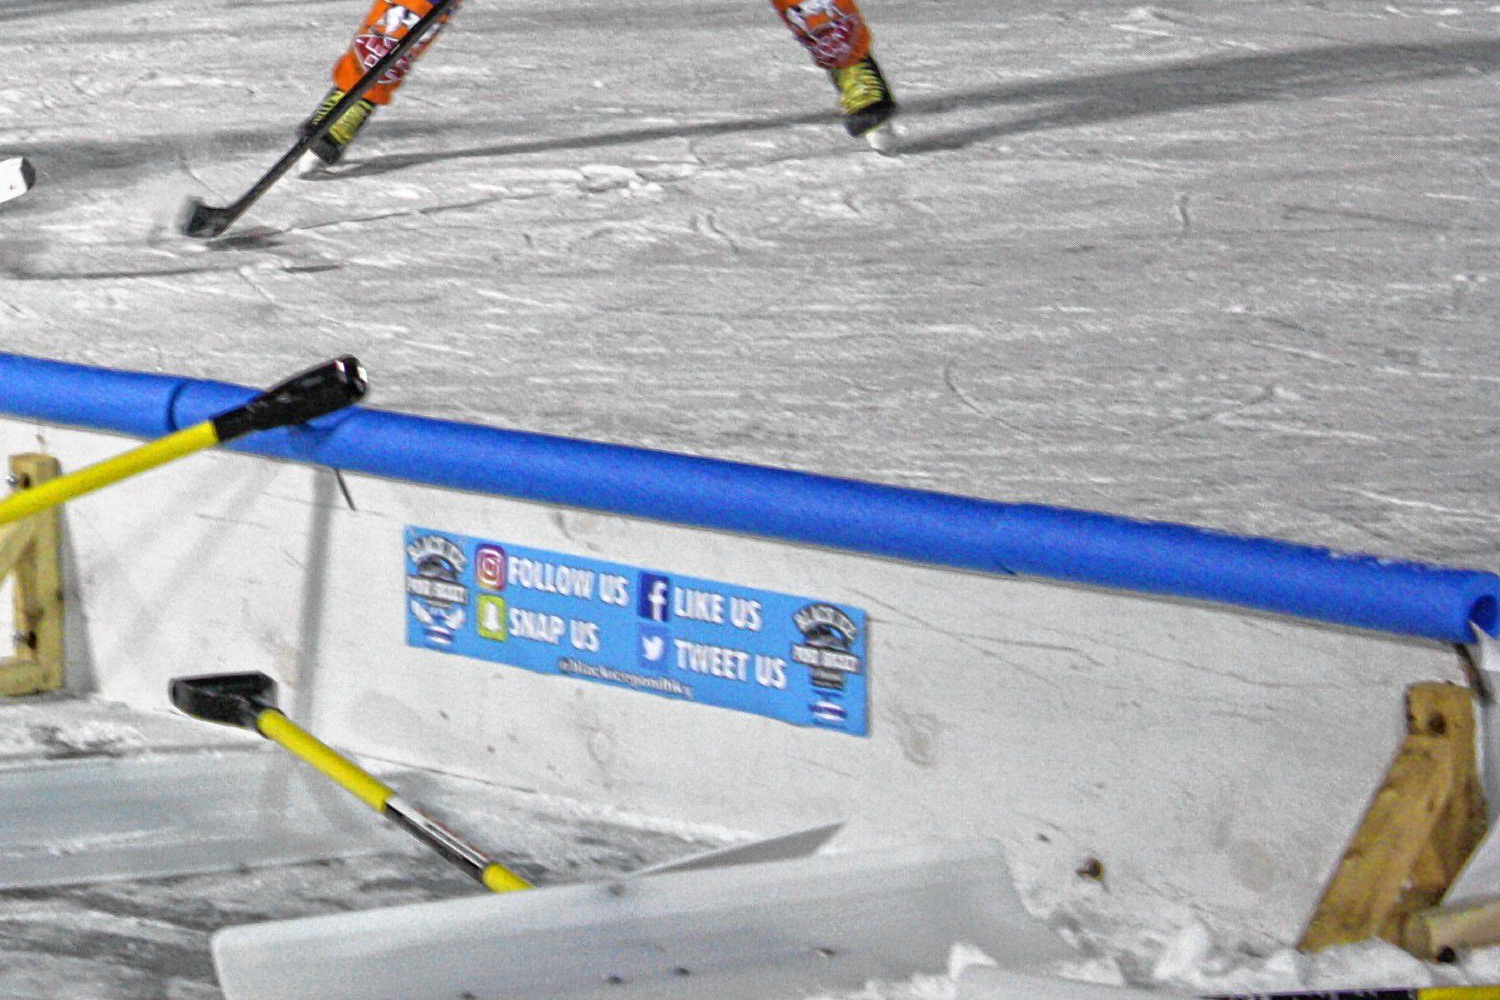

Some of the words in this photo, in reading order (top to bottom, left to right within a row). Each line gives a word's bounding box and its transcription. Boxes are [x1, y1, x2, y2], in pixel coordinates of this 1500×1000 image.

[507, 556, 595, 599] FOLLOW
[599, 573, 629, 607] US
[508, 607, 564, 644] SNAP
[570, 619, 599, 652] US
[674, 586, 725, 625] LIKE
[730, 596, 763, 632] US
[674, 638, 750, 682] TWEET
[755, 654, 787, 690] US
